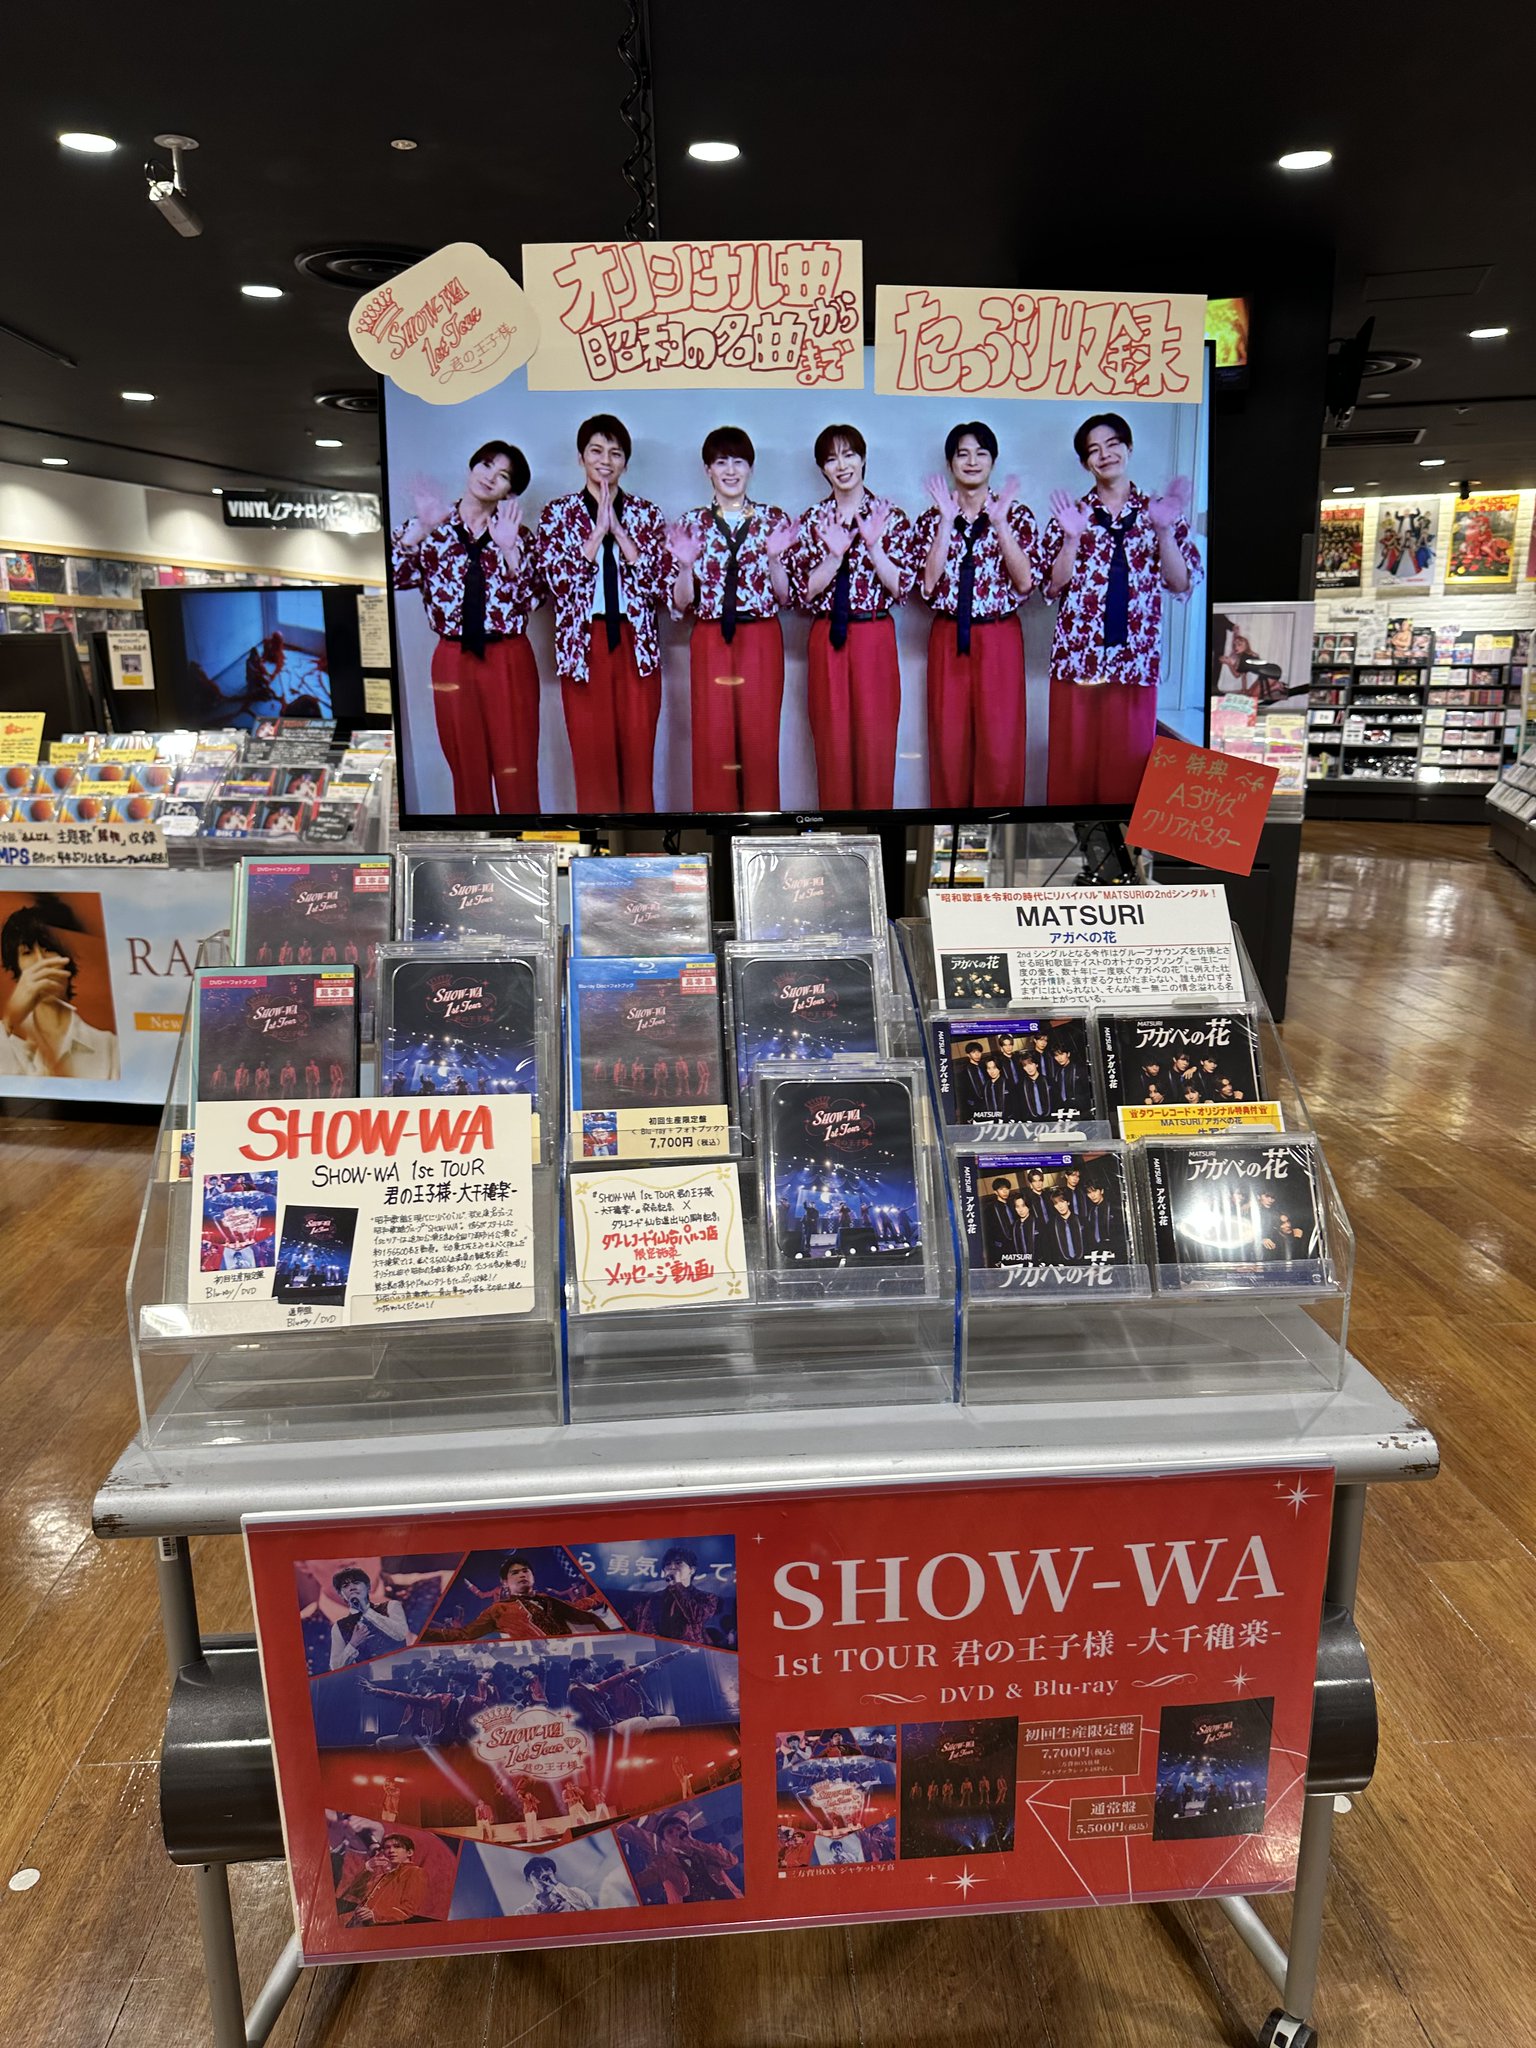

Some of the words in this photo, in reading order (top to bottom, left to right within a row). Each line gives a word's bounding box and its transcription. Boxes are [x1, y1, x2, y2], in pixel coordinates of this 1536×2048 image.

[554, 242, 842, 333] オリジナル曲
[388, 276, 470, 360] SHOW-WA
[421, 336, 450, 377] 1st
[579, 313, 807, 382] 昭和の名曲
[894, 290, 1190, 397] たっぷり収録
[796, 338, 856, 385] まで
[1185, 753, 1229, 784] 特典
[1143, 809, 1241, 849] クリアポスター
[449, 882, 495, 897] SHOW-WA
[782, 876, 825, 891] SHOW-WA
[297, 891, 339, 904] SHOW-WA
[1016, 904, 1145, 927] MATSURI
[1049, 931, 1117, 945] アガベの花
[950, 955, 1000, 970] アガベの花
[433, 986, 483, 1003] SHOW-WA
[780, 983, 826, 999] SHOW-WA
[253, 1004, 298, 1020] SHOW-WA
[626, 1006, 666, 1020] SHOW-WA
[1135, 1017, 1232, 1049] アガベの花
[648, 1115, 707, 1126] 初回生産限定盤
[812, 1108, 861, 1127] SHOW-WA
[971, 1108, 1081, 1142] アガベの花
[238, 1104, 495, 1162] SHOW-WA
[824, 1125, 839, 1142] 1st
[839, 1123, 860, 1137] Tour
[311, 1162, 400, 1187] SHOW-WA
[412, 1160, 434, 1180] 1st
[441, 1158, 486, 1178] TOUR
[1186, 1148, 1290, 1180] アガベの花
[965, 1196, 977, 1234] アガベの花
[999, 1250, 1115, 1287] アガベの花
[1001, 1253, 1033, 1261] MATSURI
[772, 1535, 1285, 1631] SHOW-WA
[775, 1653, 823, 1678] 1st
[834, 1644, 940, 1674] TOUR
[952, 1629, 1115, 1668] 君の王子様
[939, 1685, 994, 1704] DVD
[1005, 1683, 1024, 1699] &
[1033, 1677, 1119, 1699] Blu-ray
[486, 1721, 565, 1748] SHOW-WA
[1024, 1722, 1135, 1742] 初回生産限定盤
[505, 1745, 531, 1768] 1st
[529, 1741, 564, 1760] Tour
[1090, 1800, 1137, 1815] 通常盤
